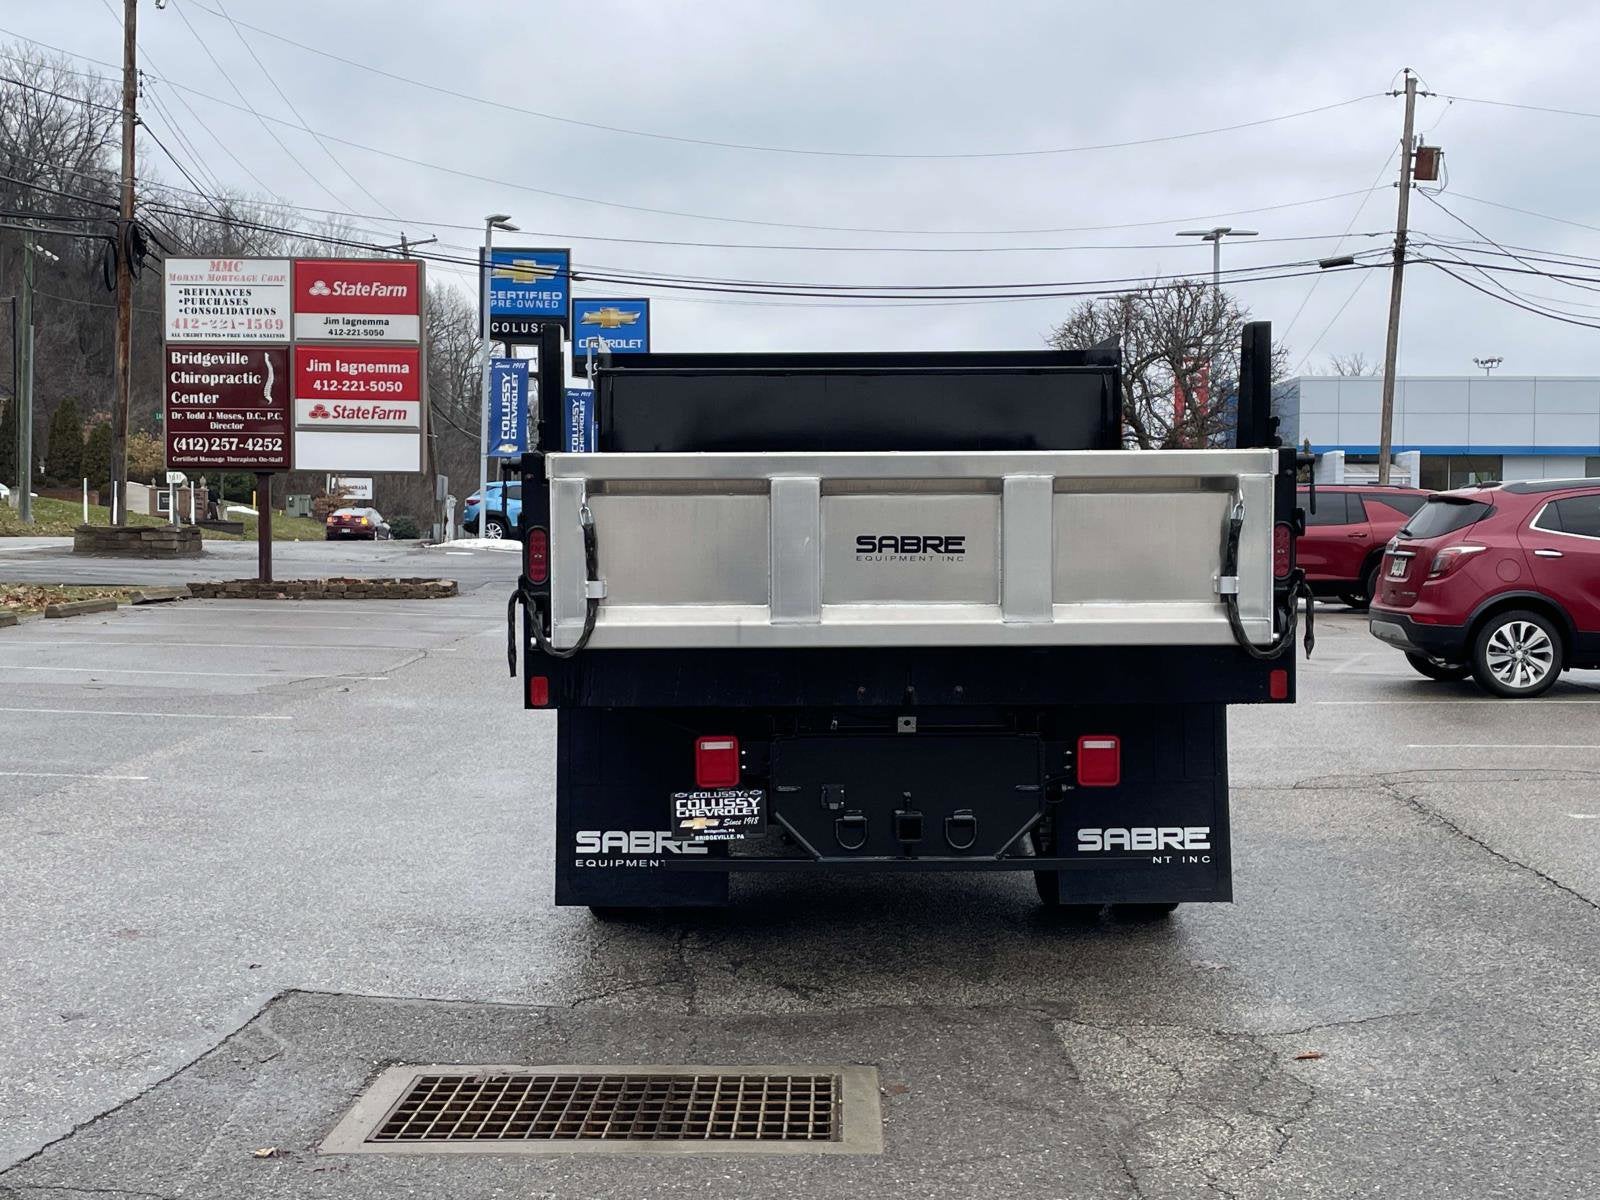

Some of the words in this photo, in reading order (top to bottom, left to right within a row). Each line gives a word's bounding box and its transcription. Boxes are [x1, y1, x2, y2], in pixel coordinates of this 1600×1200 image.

[209, 261, 243, 272] MMC
[207, 273, 258, 282] MORTGAGE
[184, 288, 252, 296] REFINANCES
[490, 291, 563, 300] CERTIFIED
[184, 298, 249, 306] PURCHASES
[491, 300, 559, 308] PRE-OWNED
[184, 307, 277, 315] CONSOLIDATIONS
[171, 318, 284, 330] 412-221-1569
[323, 317, 340, 325] Jim
[342, 317, 390, 327] Iagnemma
[492, 323, 544, 333] COLUS
[171, 352, 249, 367] Bridgeville
[306, 360, 331, 372] Jim
[336, 360, 410, 375] Iagnemma
[171, 371, 261, 386] Chiropractic
[313, 380, 403, 392] 412-221-5050
[171, 391, 219, 404] Center
[501, 373, 511, 439] COLUSSY
[171, 412, 184, 420] Dr.
[186, 412, 205, 420] Todd
[207, 412, 214, 420] J.
[216, 412, 244, 420] Moses,
[267, 412, 283, 420] P.C.
[210, 422, 244, 430] Director
[856, 536, 966, 554] SABRE
[693, 791, 744, 799] COLUSSY
[676, 797, 761, 810] COLUSSY
[676, 807, 760, 817] CHEVROLET
[723, 818, 742, 826] Since
[576, 831, 708, 854] SABRE
[1077, 827, 1210, 851] SABRE
[1152, 856, 1172, 864] NT
[1182, 856, 1211, 864] INC
